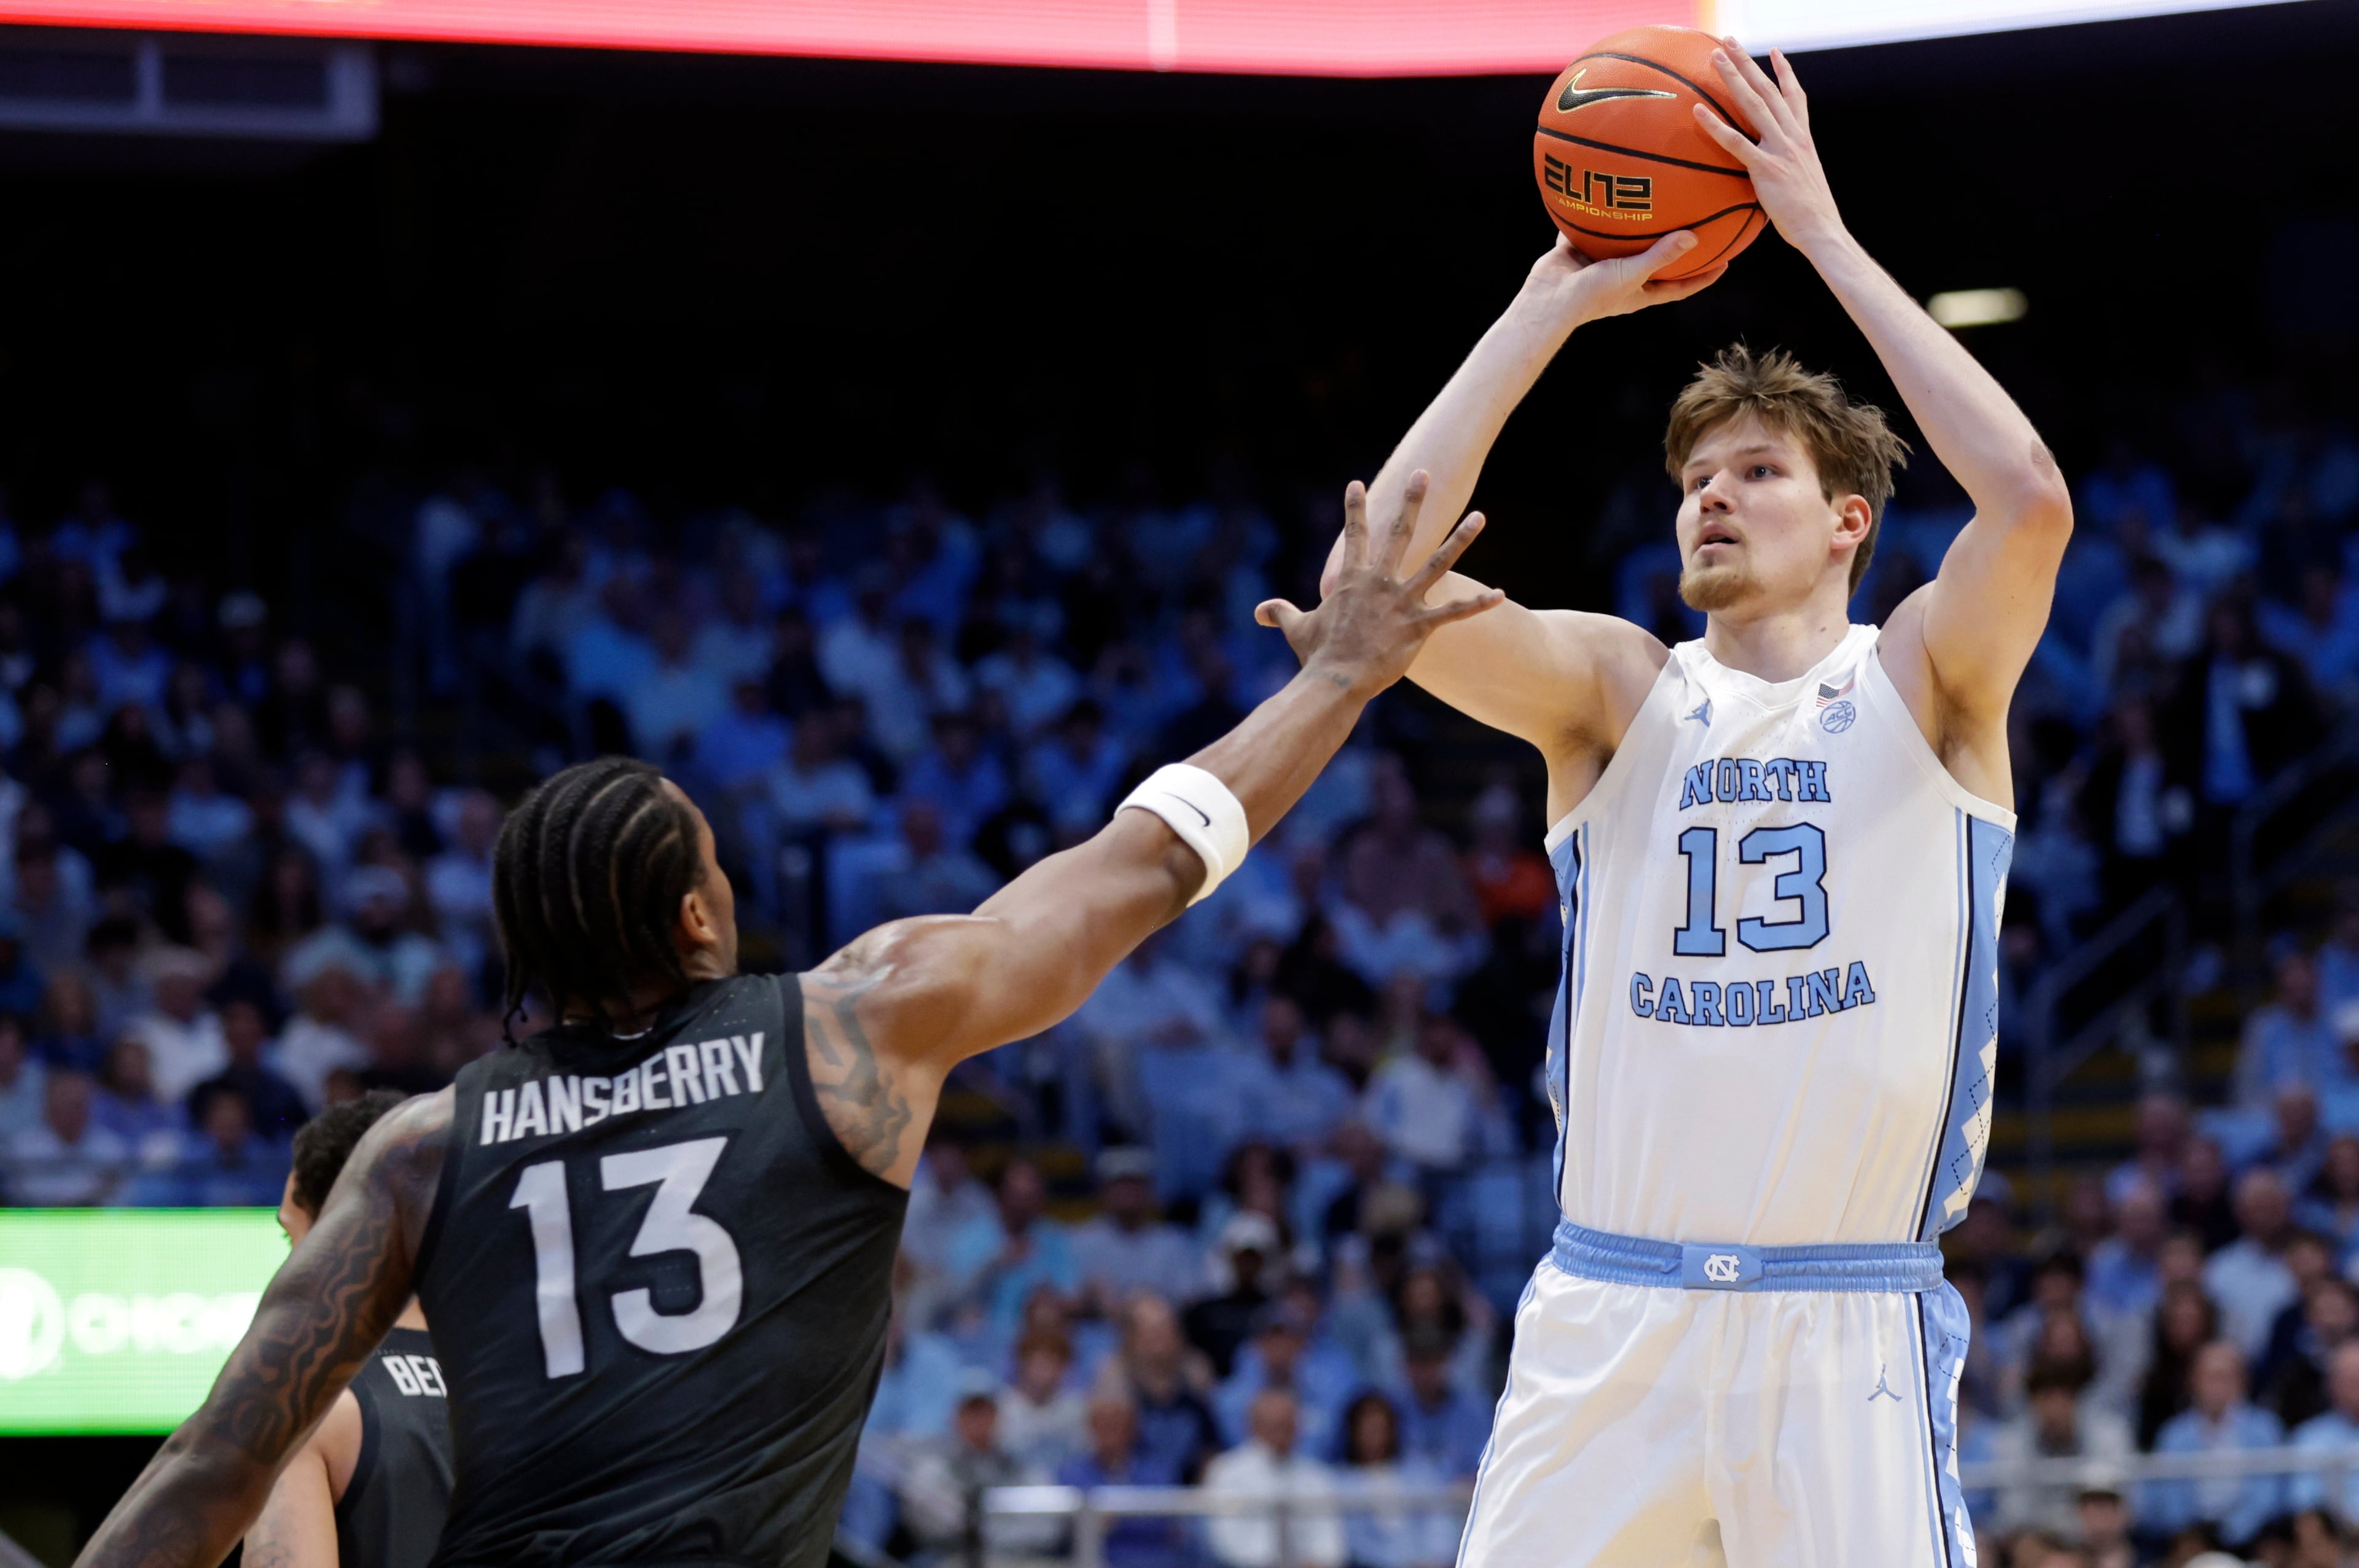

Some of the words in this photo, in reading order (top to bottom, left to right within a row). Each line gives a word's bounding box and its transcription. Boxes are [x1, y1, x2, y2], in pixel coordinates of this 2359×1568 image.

[1544, 152, 1653, 211] ELITE
[1679, 757, 1831, 811] NORTH
[1673, 822, 1829, 957] 13
[1630, 961, 1876, 1027] CAROLINA
[480, 1032, 765, 1145] HANSBERRY
[509, 1136, 743, 1379] 13
